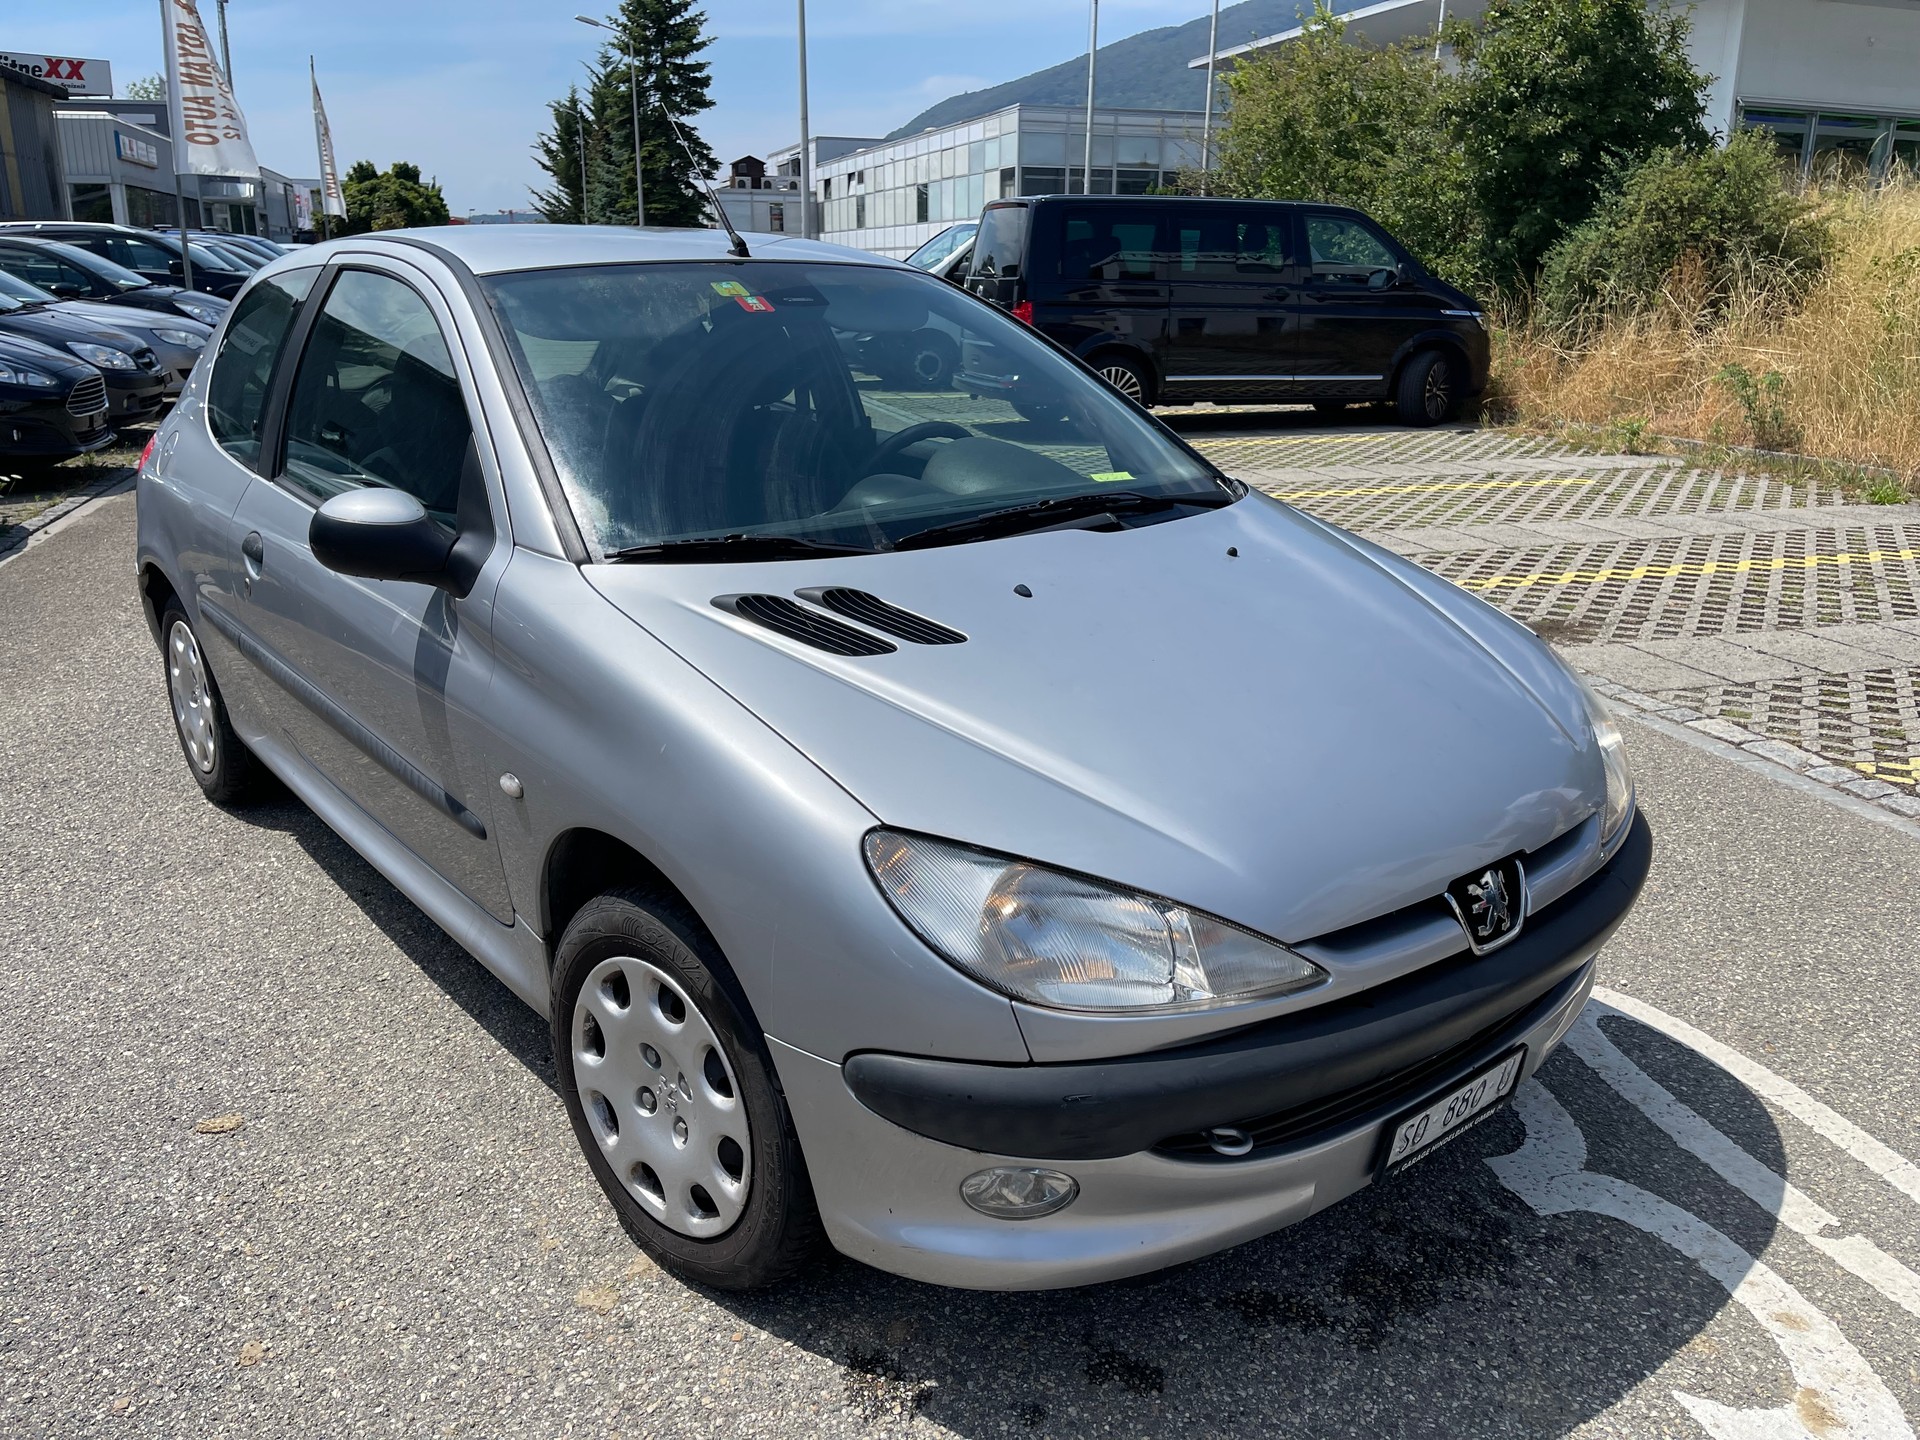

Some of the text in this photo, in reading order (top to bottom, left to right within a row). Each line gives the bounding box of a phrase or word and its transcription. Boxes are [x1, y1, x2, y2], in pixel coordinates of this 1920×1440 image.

[749, 303, 766, 311] 20
[640, 925, 710, 994] SAVA
[1398, 1057, 1516, 1153] SO 880 U
[1402, 1148, 1431, 1170] GARAGE
